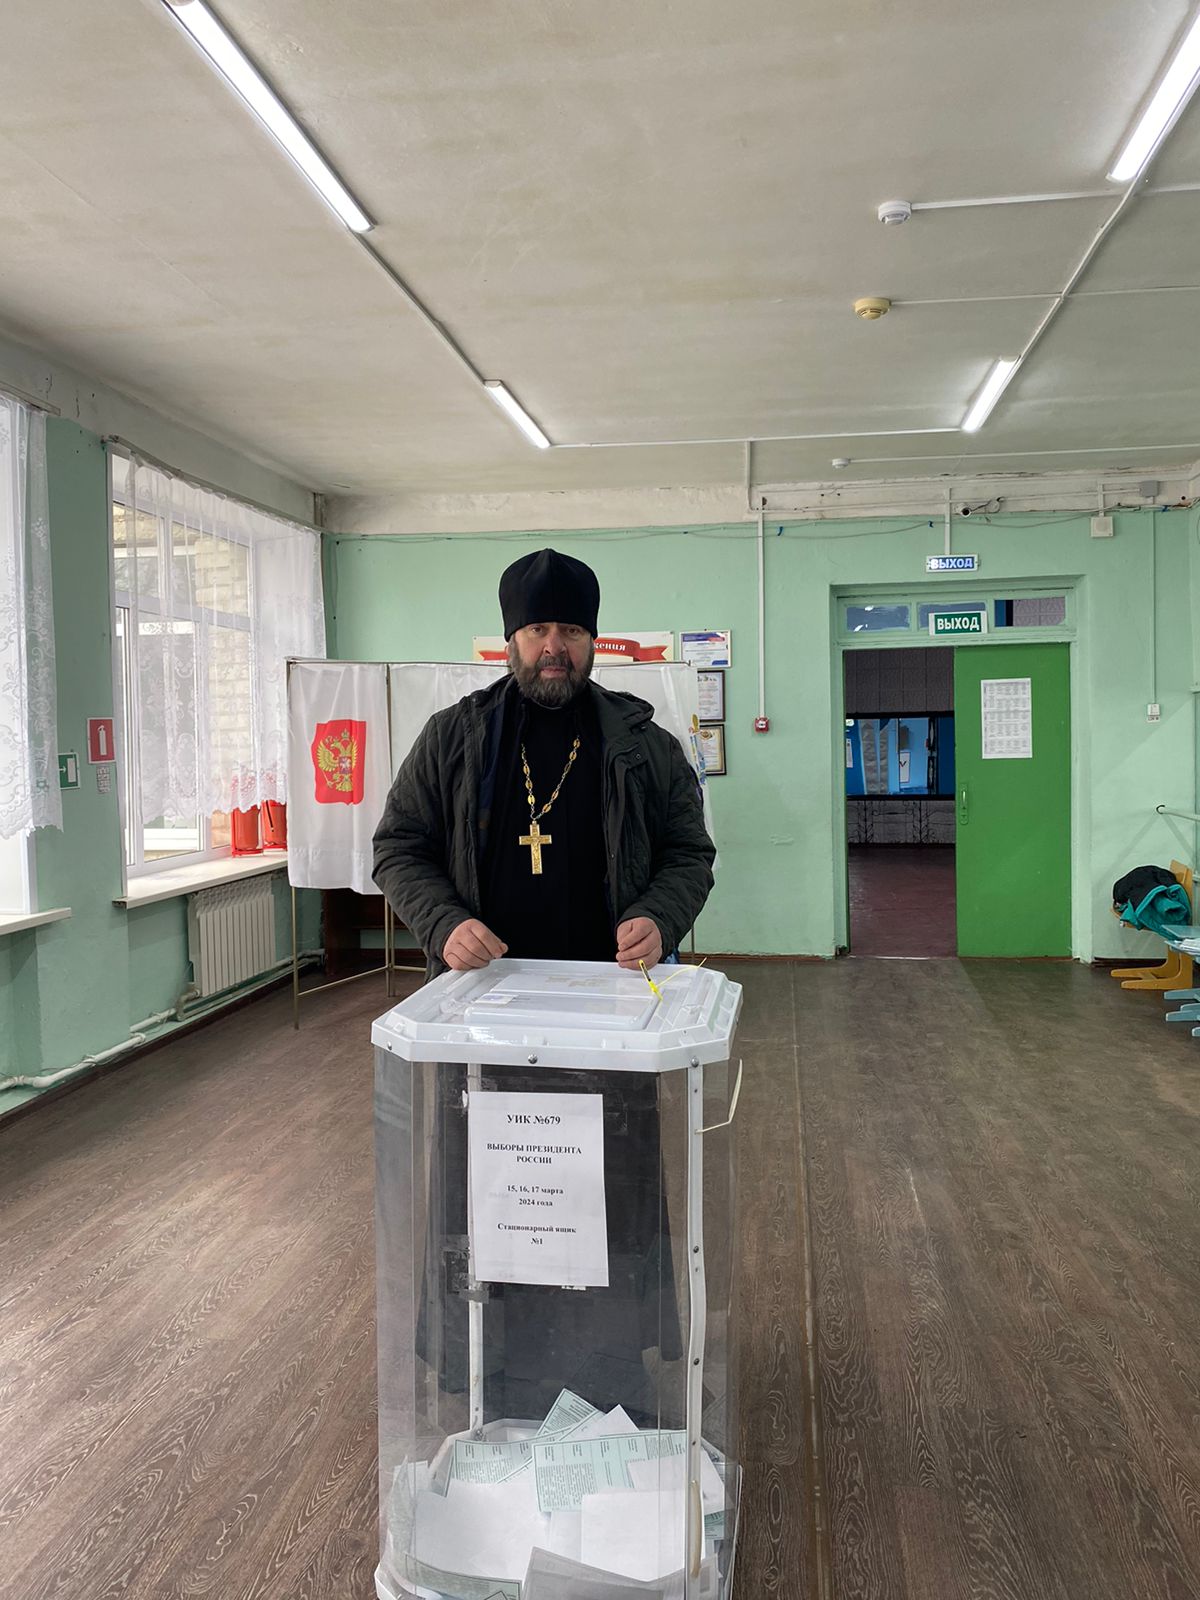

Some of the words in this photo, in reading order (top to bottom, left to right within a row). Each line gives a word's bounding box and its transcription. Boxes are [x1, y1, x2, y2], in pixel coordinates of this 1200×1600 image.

[930, 558, 973, 570] ВЫХОД
[937, 616, 980, 631] ВЫХОД
[506, 1114, 531, 1124] УИК
[533, 1115, 561, 1125] №679
[487, 1143, 524, 1152] ВЫБОРЫ
[526, 1144, 582, 1154] ПРЕЗИДЕНТА
[516, 1155, 552, 1164] РОССИИ
[519, 1185, 530, 1193] 16,
[519, 1198, 535, 1206] 2024
[497, 1222, 554, 1233] Стационарный
[530, 1237, 543, 1245] №1
